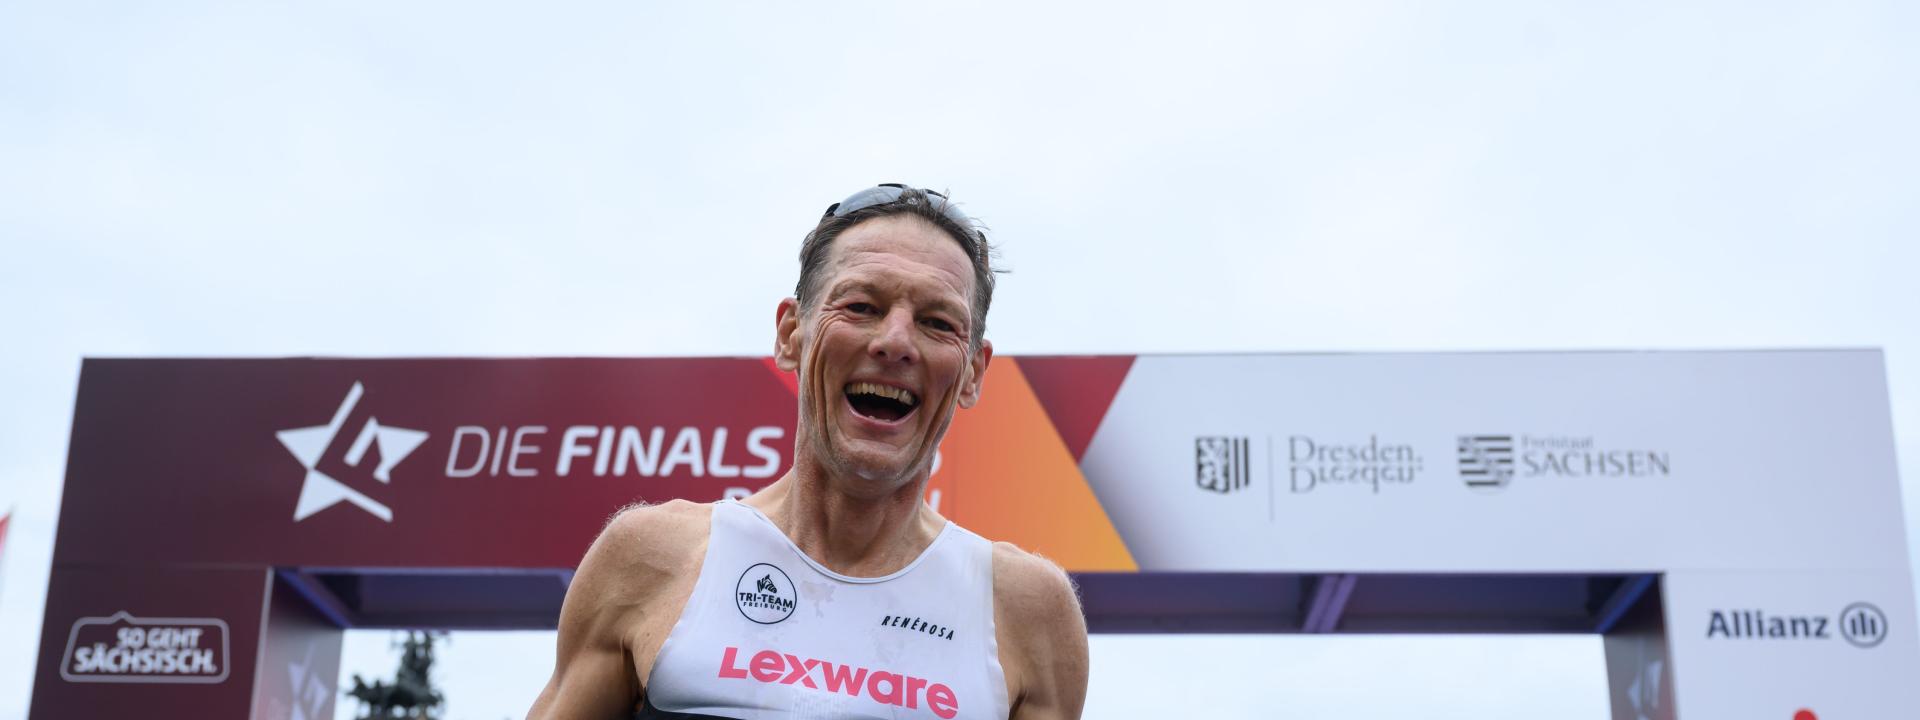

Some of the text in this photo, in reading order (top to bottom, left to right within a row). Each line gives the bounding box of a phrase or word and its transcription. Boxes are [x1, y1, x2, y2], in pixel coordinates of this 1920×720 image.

[445, 425, 784, 478] DIE FINALS
[1522, 451, 1670, 477] SACHSEN
[739, 592, 793, 608] TRI-TEAM
[743, 601, 787, 612] FREIBURG
[881, 615, 955, 640] RENÉROSA
[1707, 610, 1830, 639] Allianz
[117, 627, 203, 649] SO GEHT
[718, 646, 959, 720] Lexware
